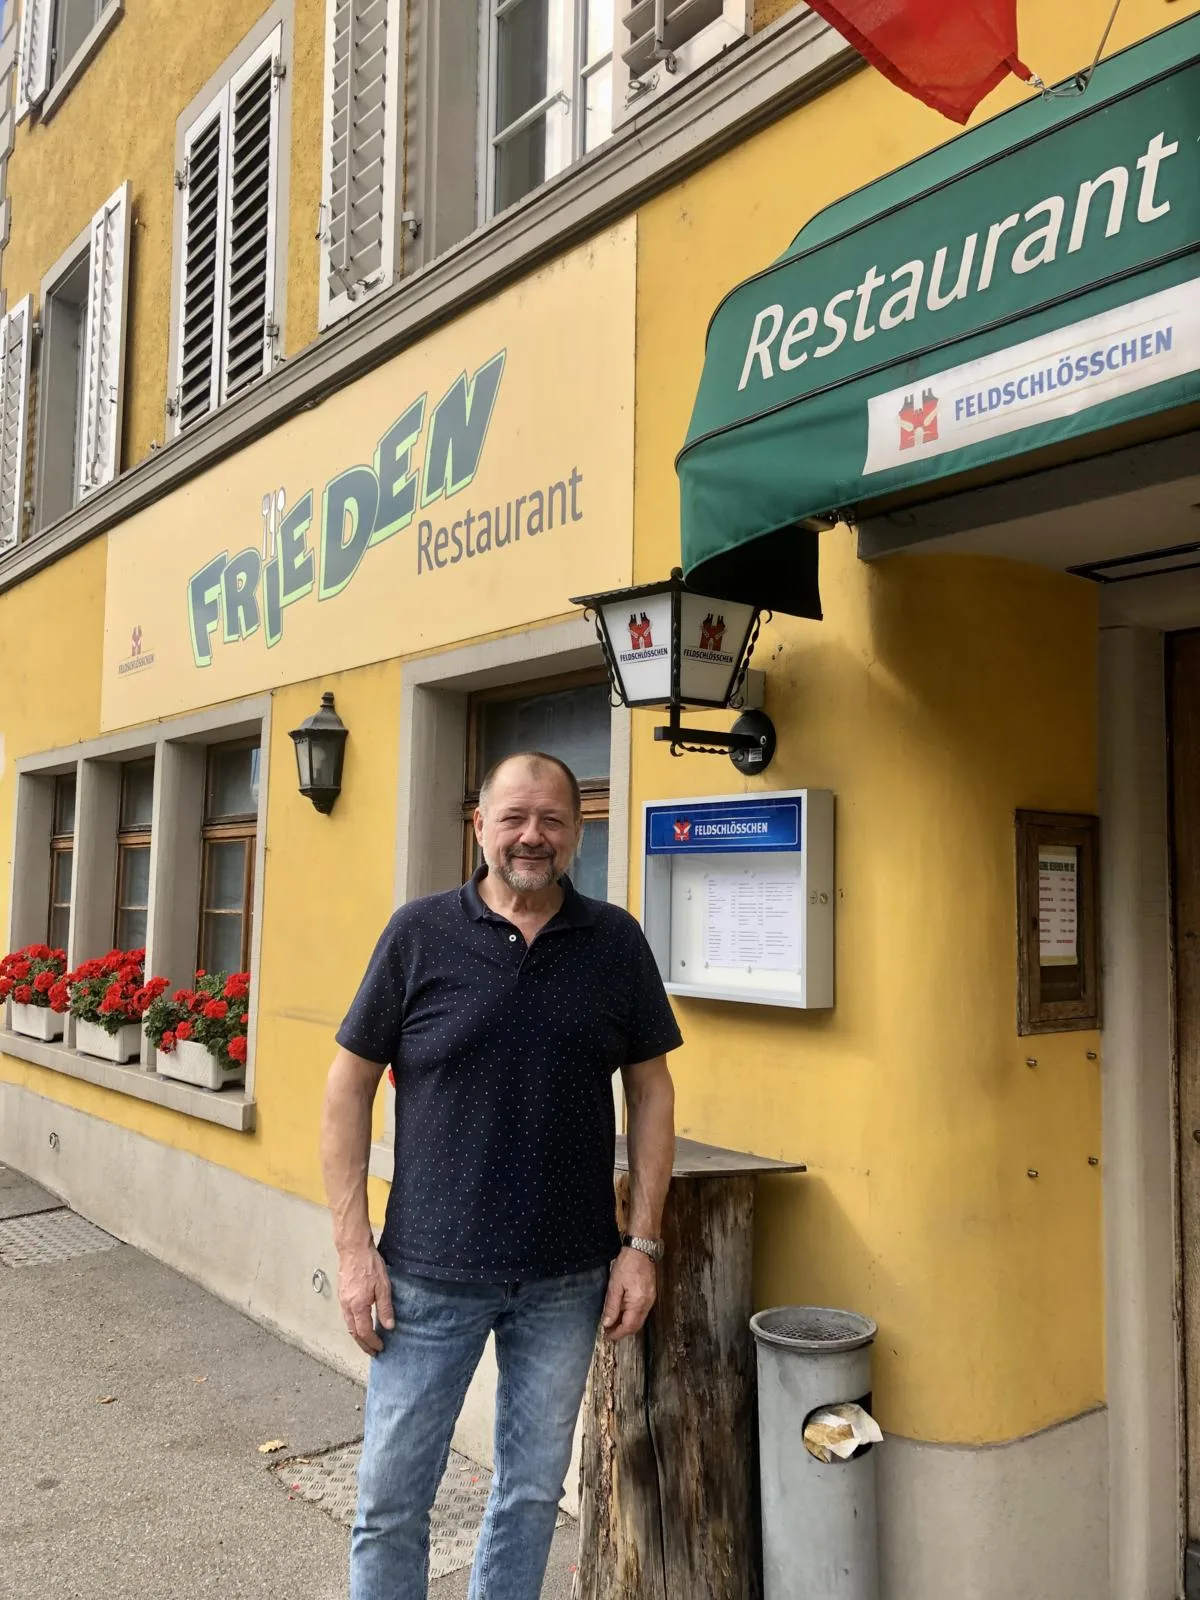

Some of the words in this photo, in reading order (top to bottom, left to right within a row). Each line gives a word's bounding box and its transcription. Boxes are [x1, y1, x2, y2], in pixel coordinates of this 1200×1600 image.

[737, 131, 1178, 392] Restaurant
[954, 326, 1173, 420] FELDSCHLÖSSCHEN
[187, 347, 507, 668] FRIEDEN
[417, 466, 583, 575] Restaurant
[620, 647, 668, 662] FELDSCHLÖSSCHEN
[683, 648, 733, 663] FELDSCHLÖSSCHEN
[694, 821, 768, 835] FELDSCHLÖSSCHEN
